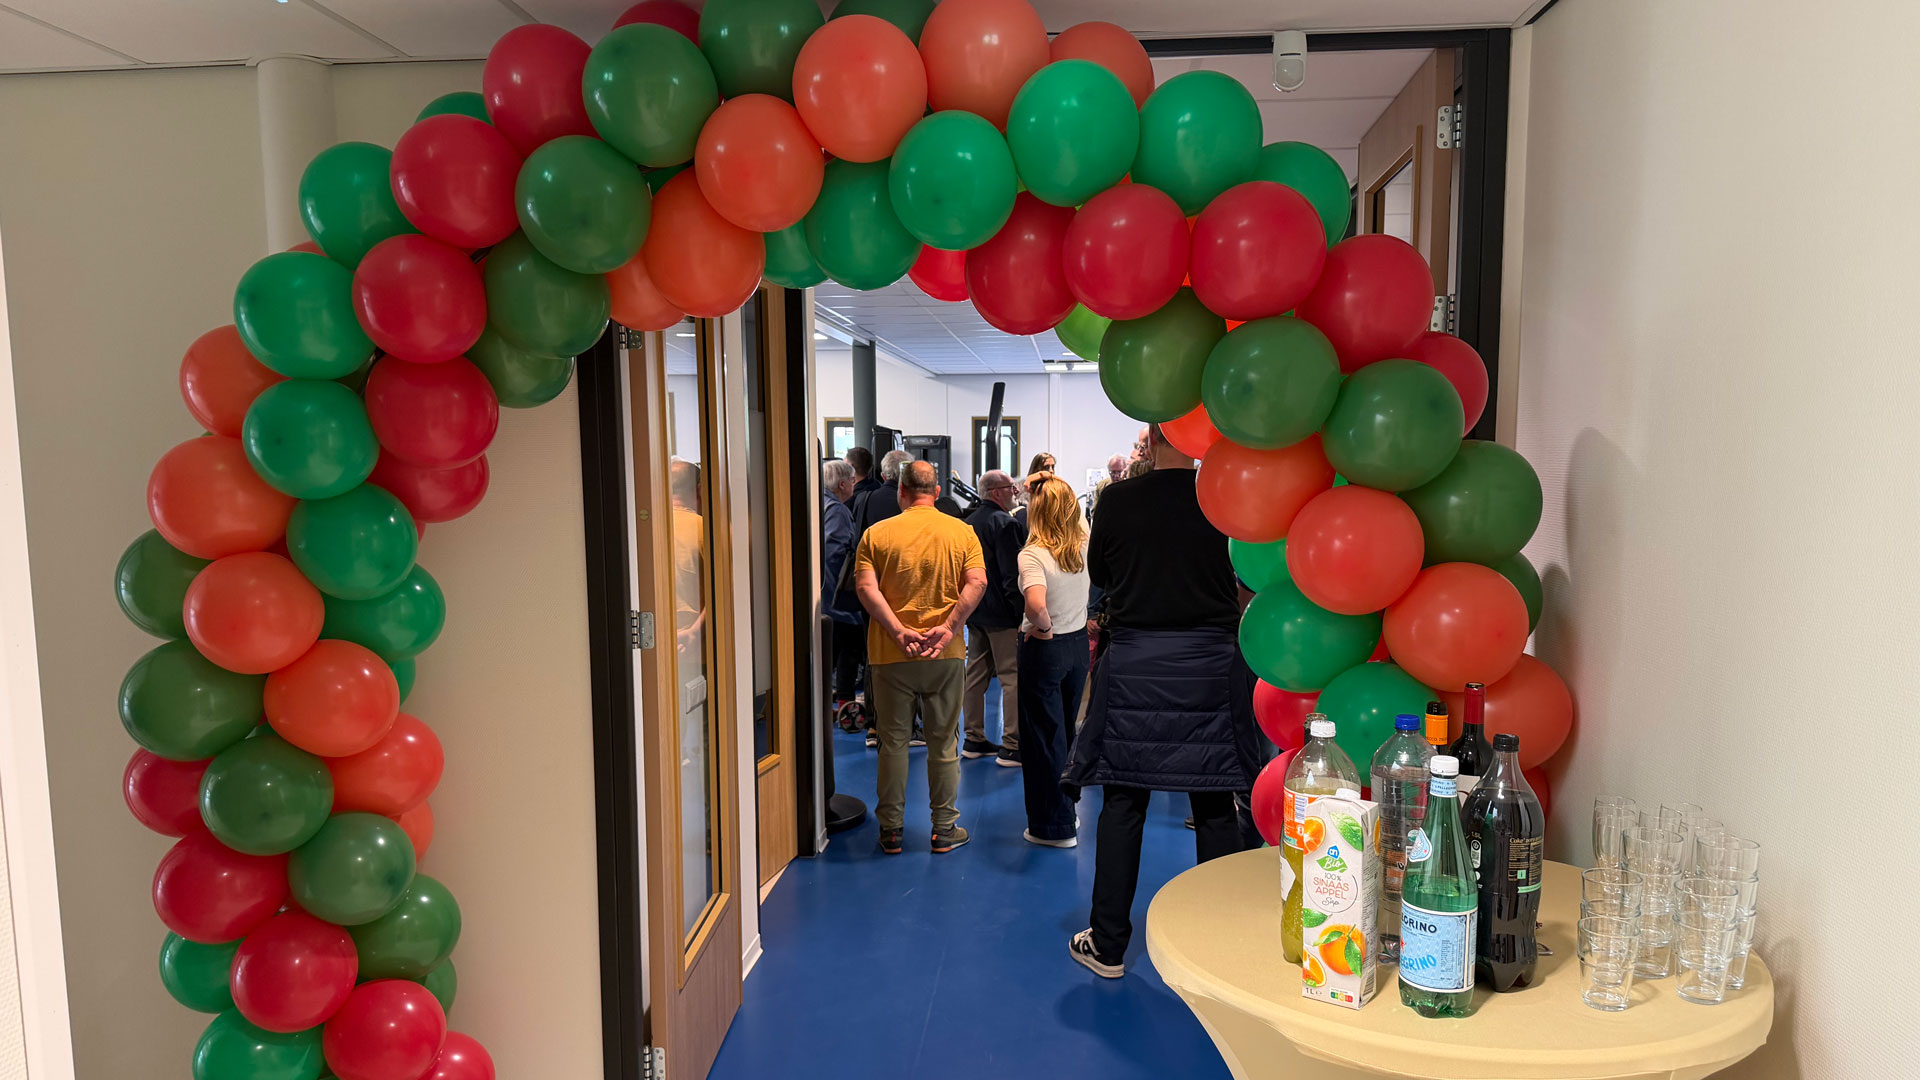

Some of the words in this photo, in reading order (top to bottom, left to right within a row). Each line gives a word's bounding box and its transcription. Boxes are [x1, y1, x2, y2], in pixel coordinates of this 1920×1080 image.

[1323, 857, 1344, 869] Bio
[1313, 876, 1350, 892] SINAAS
[1315, 886, 1347, 900] APPEL
